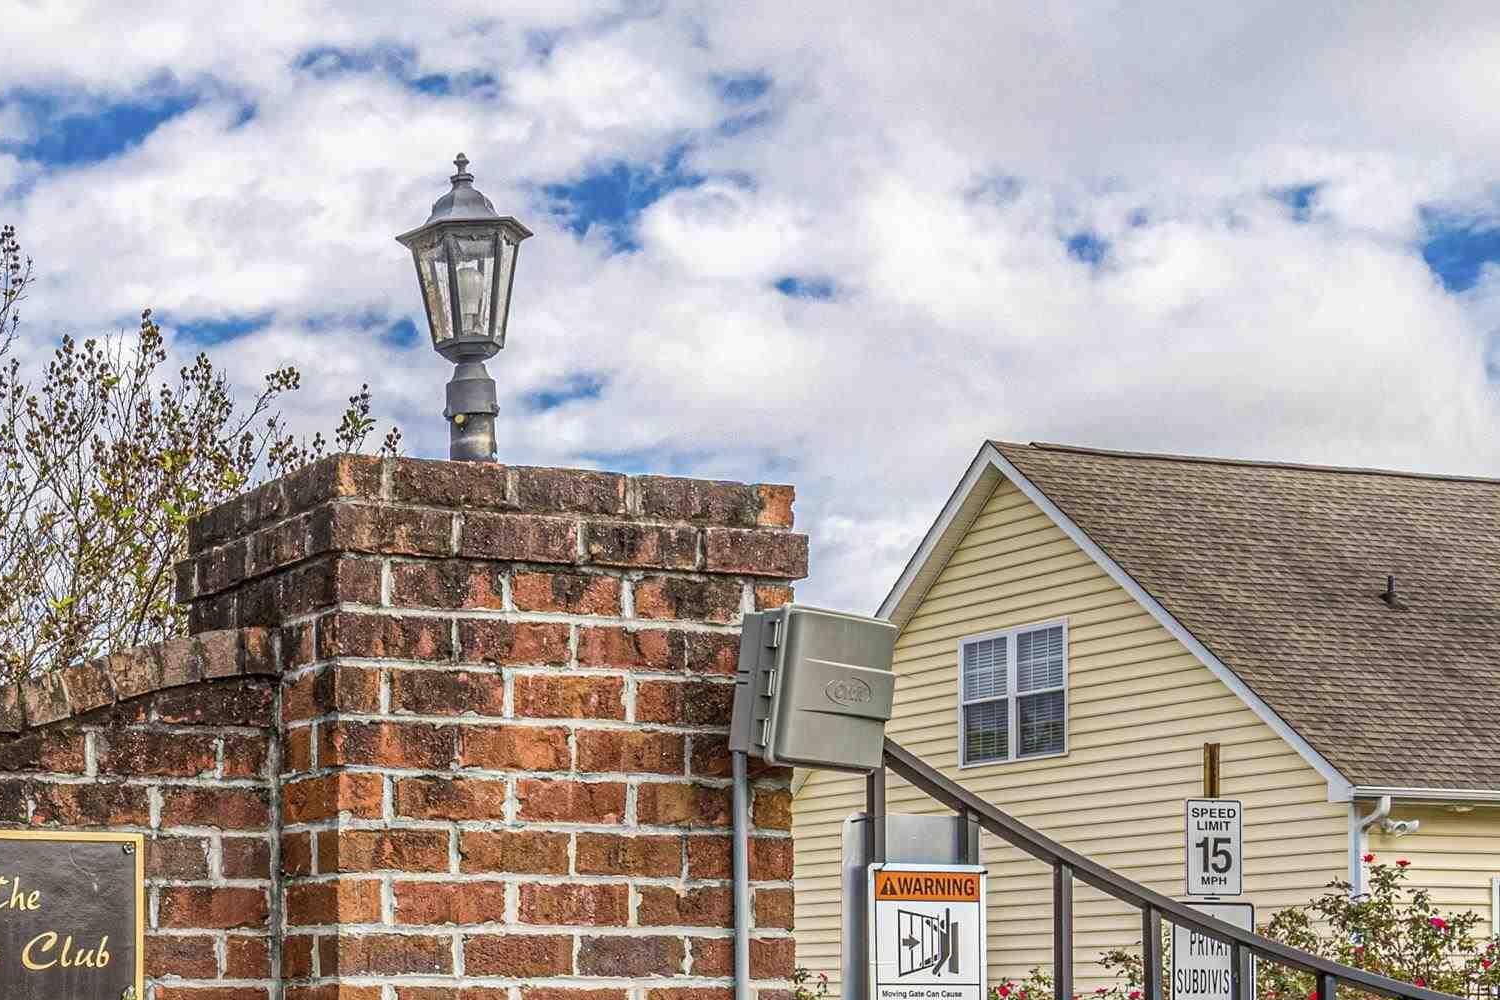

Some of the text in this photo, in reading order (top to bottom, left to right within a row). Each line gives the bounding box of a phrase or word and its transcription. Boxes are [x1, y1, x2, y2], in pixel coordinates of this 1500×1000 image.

[1191, 808, 1237, 819] SPEED
[1197, 820, 1231, 831] LIMIT
[1195, 836, 1232, 874] 15
[897, 877, 975, 896] WARNING
[1201, 876, 1228, 886] MPH
[21, 930, 111, 971] Club
[1176, 968, 1230, 994] SUBDIVIS
[882, 990, 963, 999] Moving Gate Can Cause
